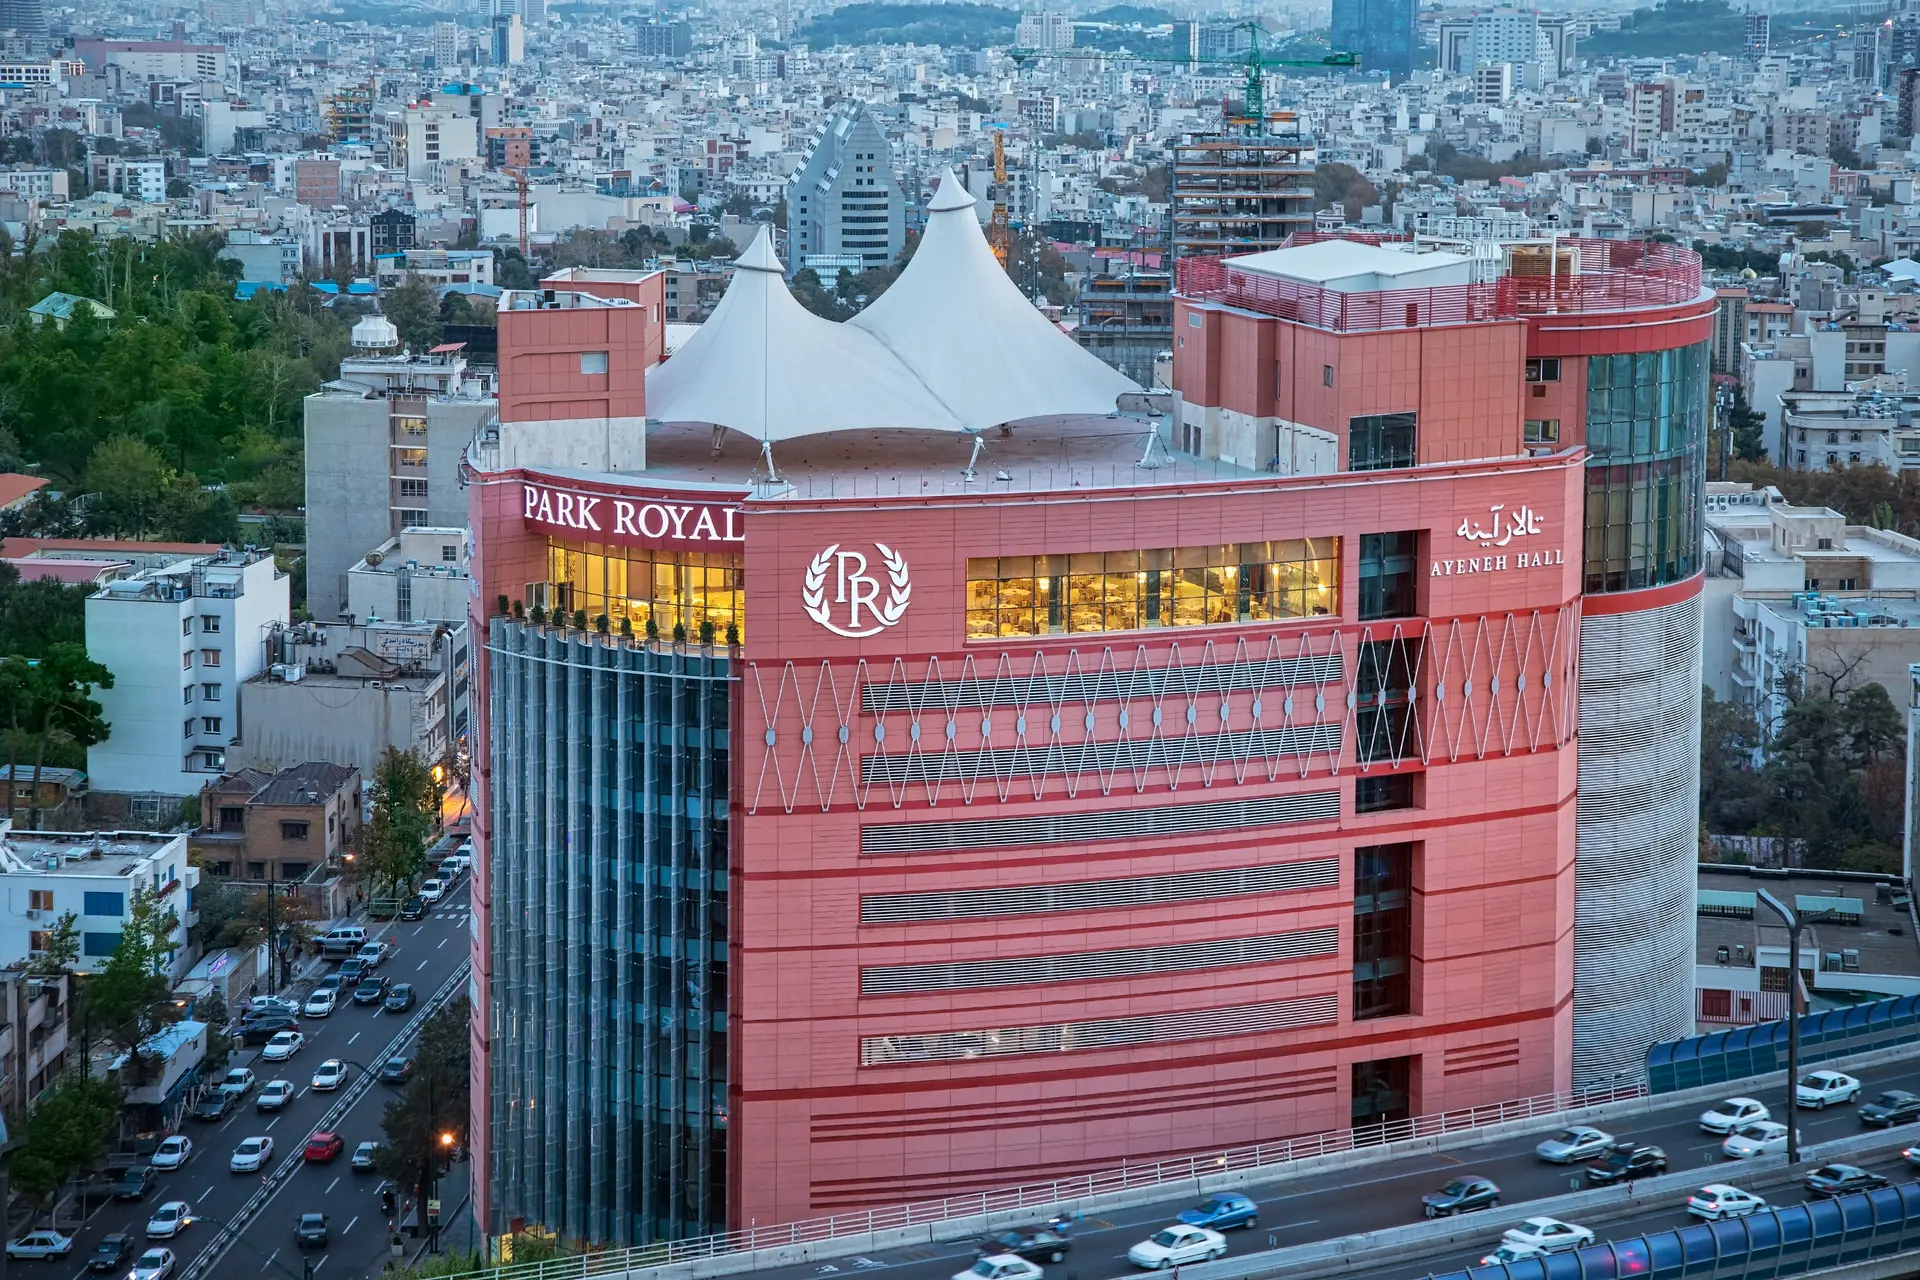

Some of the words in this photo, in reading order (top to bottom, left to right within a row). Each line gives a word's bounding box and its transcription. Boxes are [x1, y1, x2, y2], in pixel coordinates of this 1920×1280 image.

[523, 485, 602, 532] PARK
[613, 499, 746, 542] ROYAL
[1456, 503, 1504, 548] آینه
[1494, 504, 1544, 547] تالار
[1431, 555, 1508, 577] AYENEH
[1516, 549, 1565, 568] HALL
